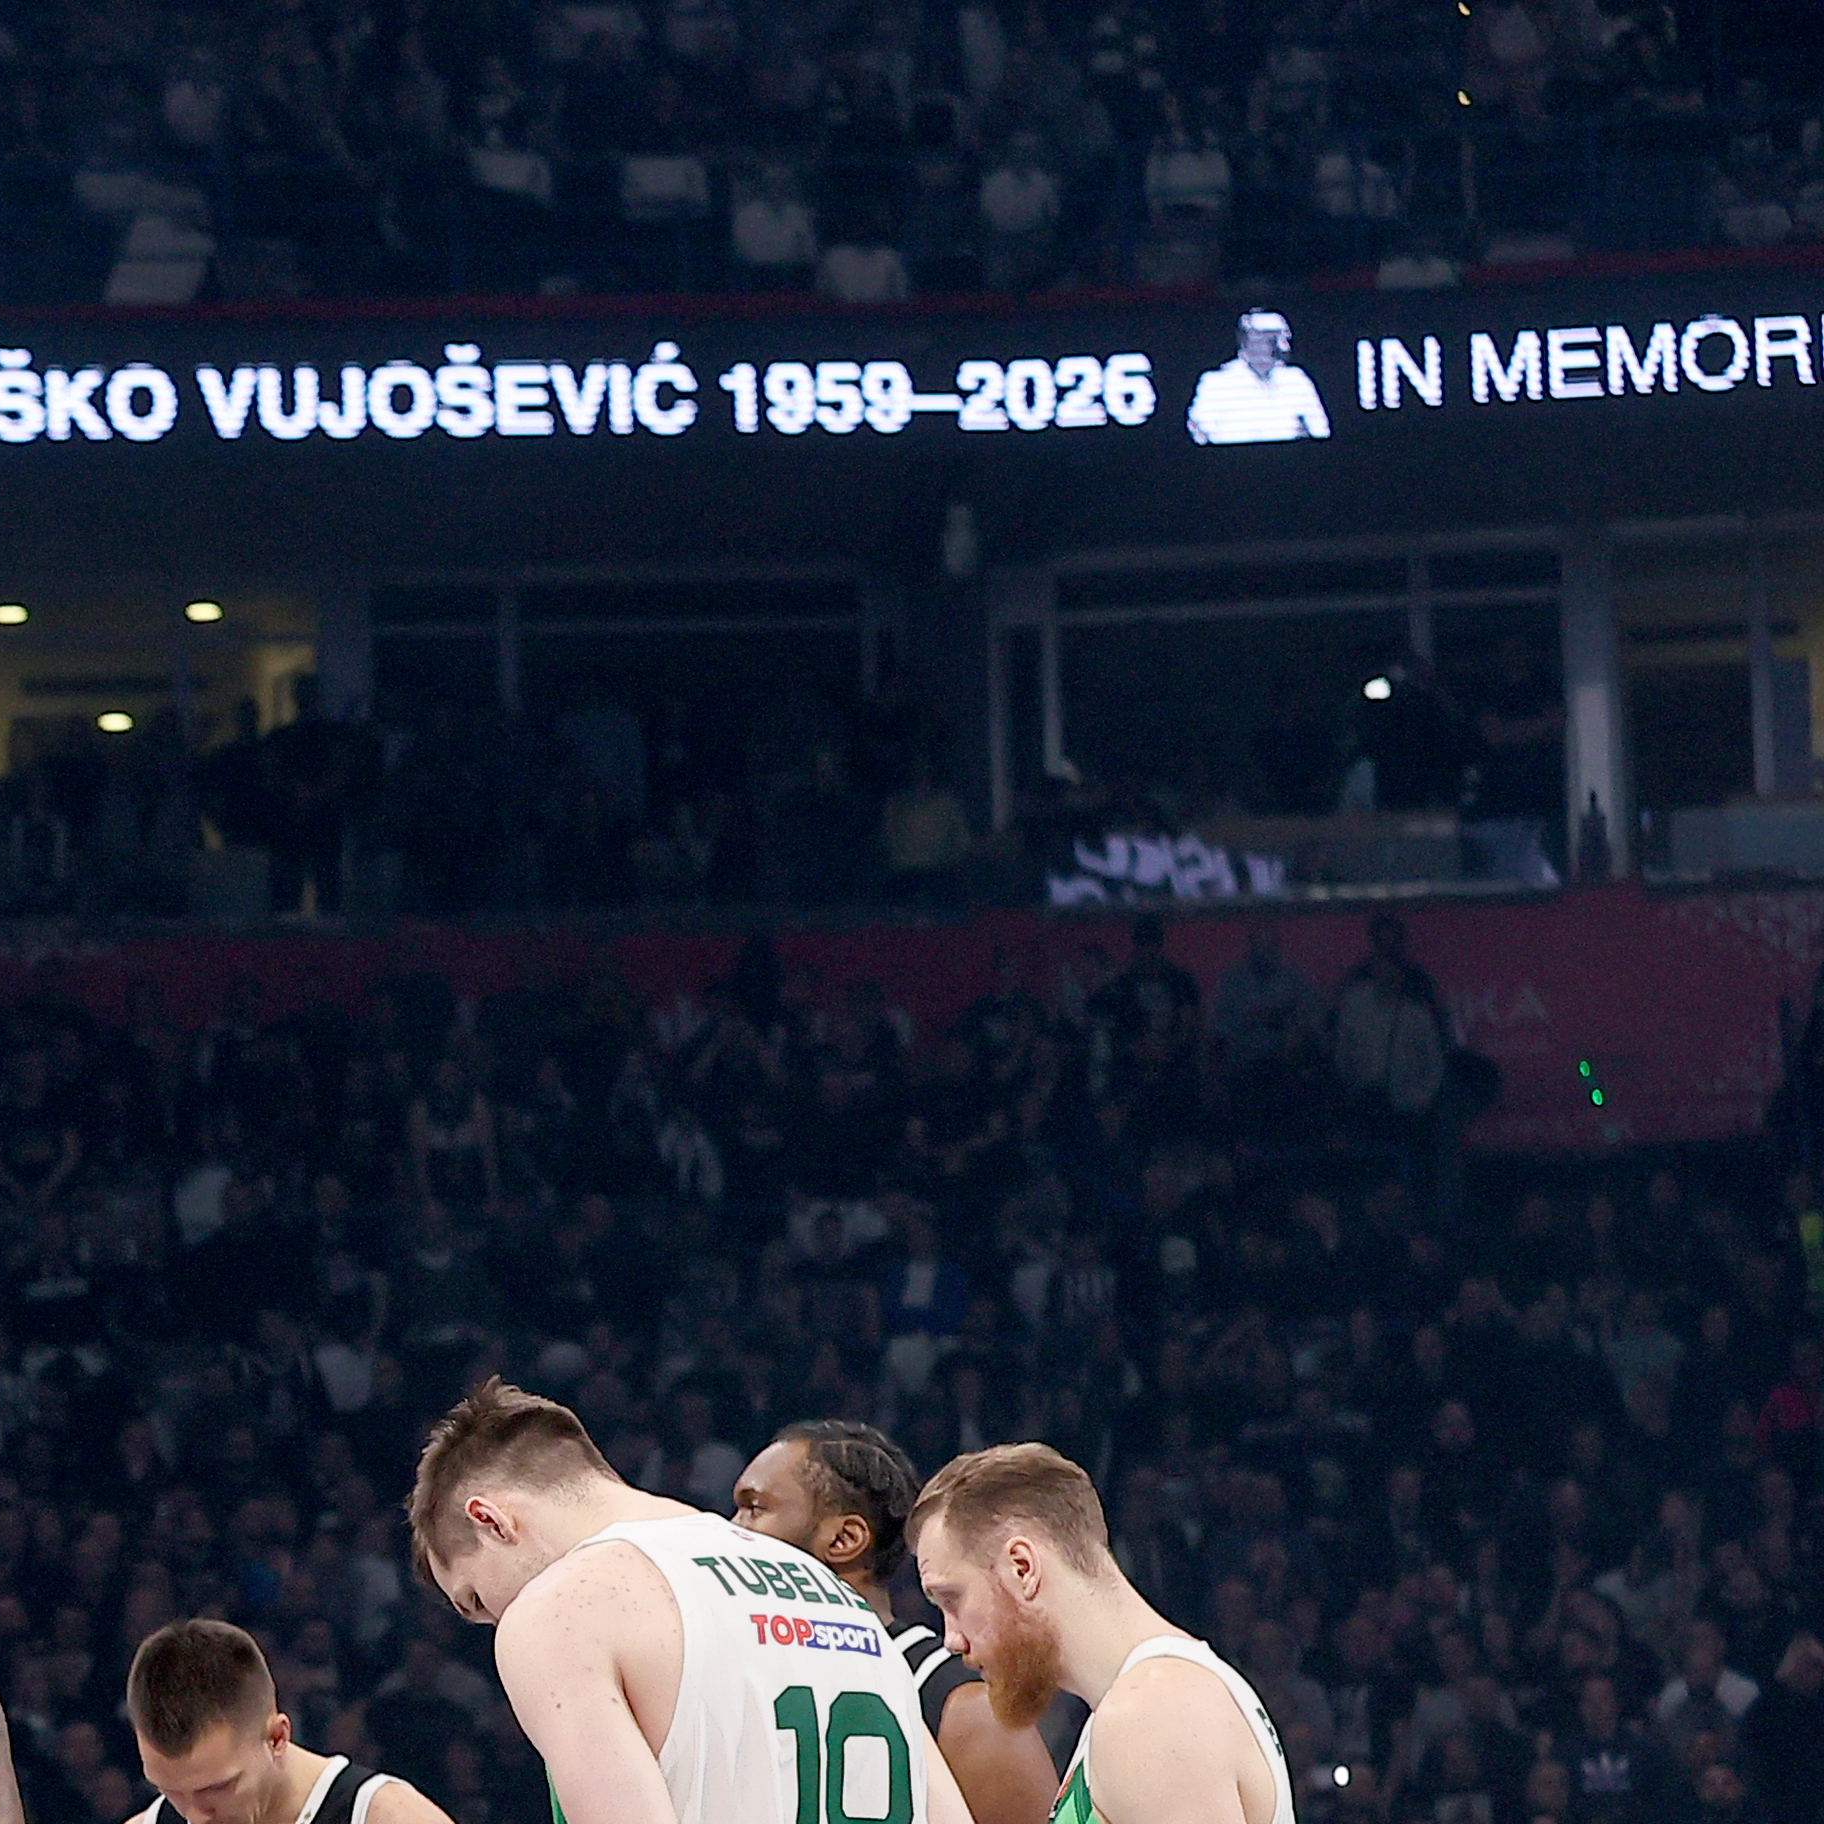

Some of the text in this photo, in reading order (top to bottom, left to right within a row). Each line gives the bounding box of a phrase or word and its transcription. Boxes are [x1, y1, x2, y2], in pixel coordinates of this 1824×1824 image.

[195, 341, 699, 440] VUJOŠEVIĆ
[1356, 313, 1824, 411] IN MEMOR
